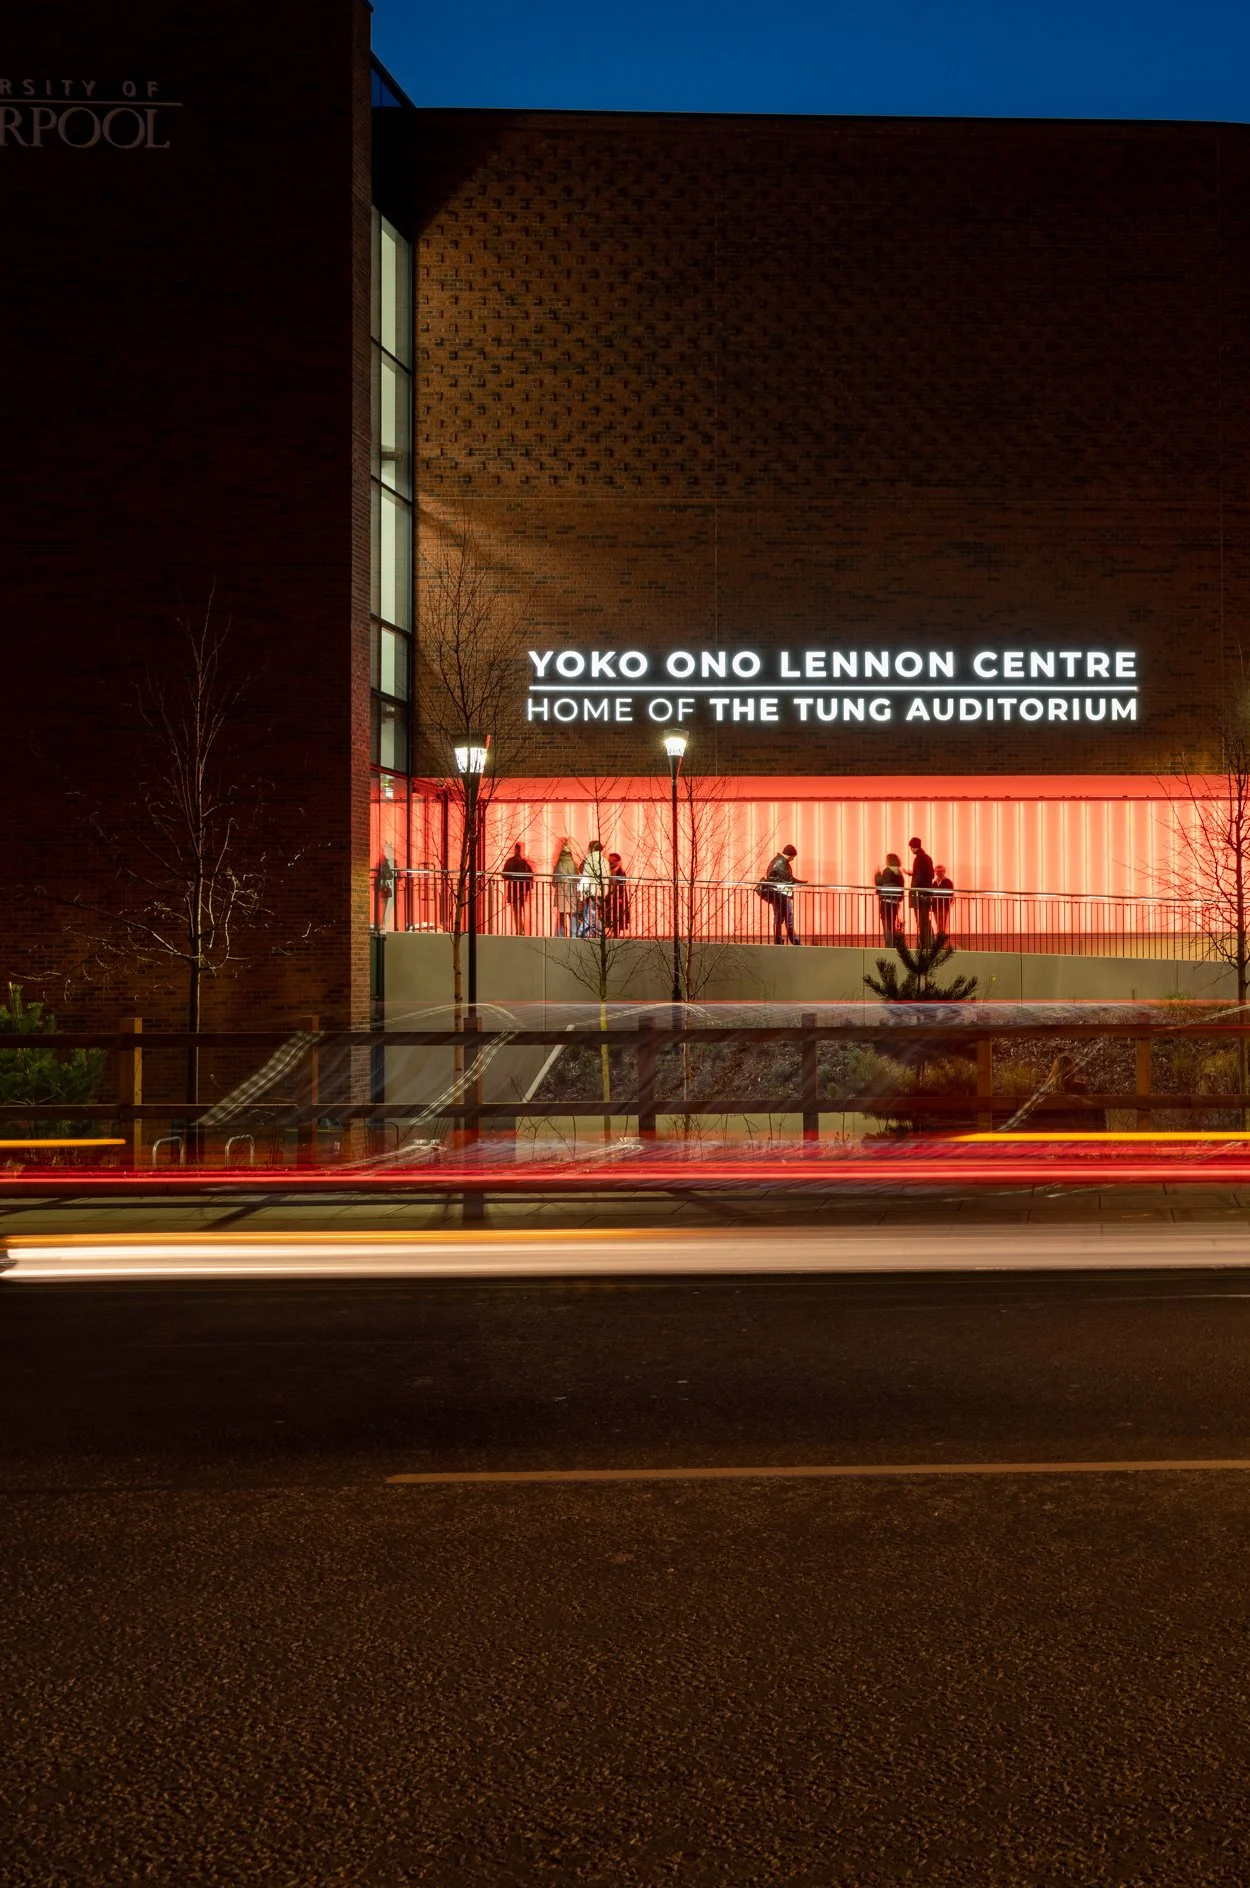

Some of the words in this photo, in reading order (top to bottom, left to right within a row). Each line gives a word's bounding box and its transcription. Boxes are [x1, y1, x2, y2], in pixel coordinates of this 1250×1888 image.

[122, 80, 159, 98] OF
[528, 650, 648, 678] YOKO
[666, 650, 761, 678] ONO
[780, 650, 954, 678] LENNON
[973, 650, 1137, 678] CENTRE
[528, 698, 633, 722] HOME
[648, 697, 695, 722] OF
[709, 698, 779, 721] THE
[793, 698, 891, 722] TUNG
[906, 698, 1137, 722] AUDITORIUM
